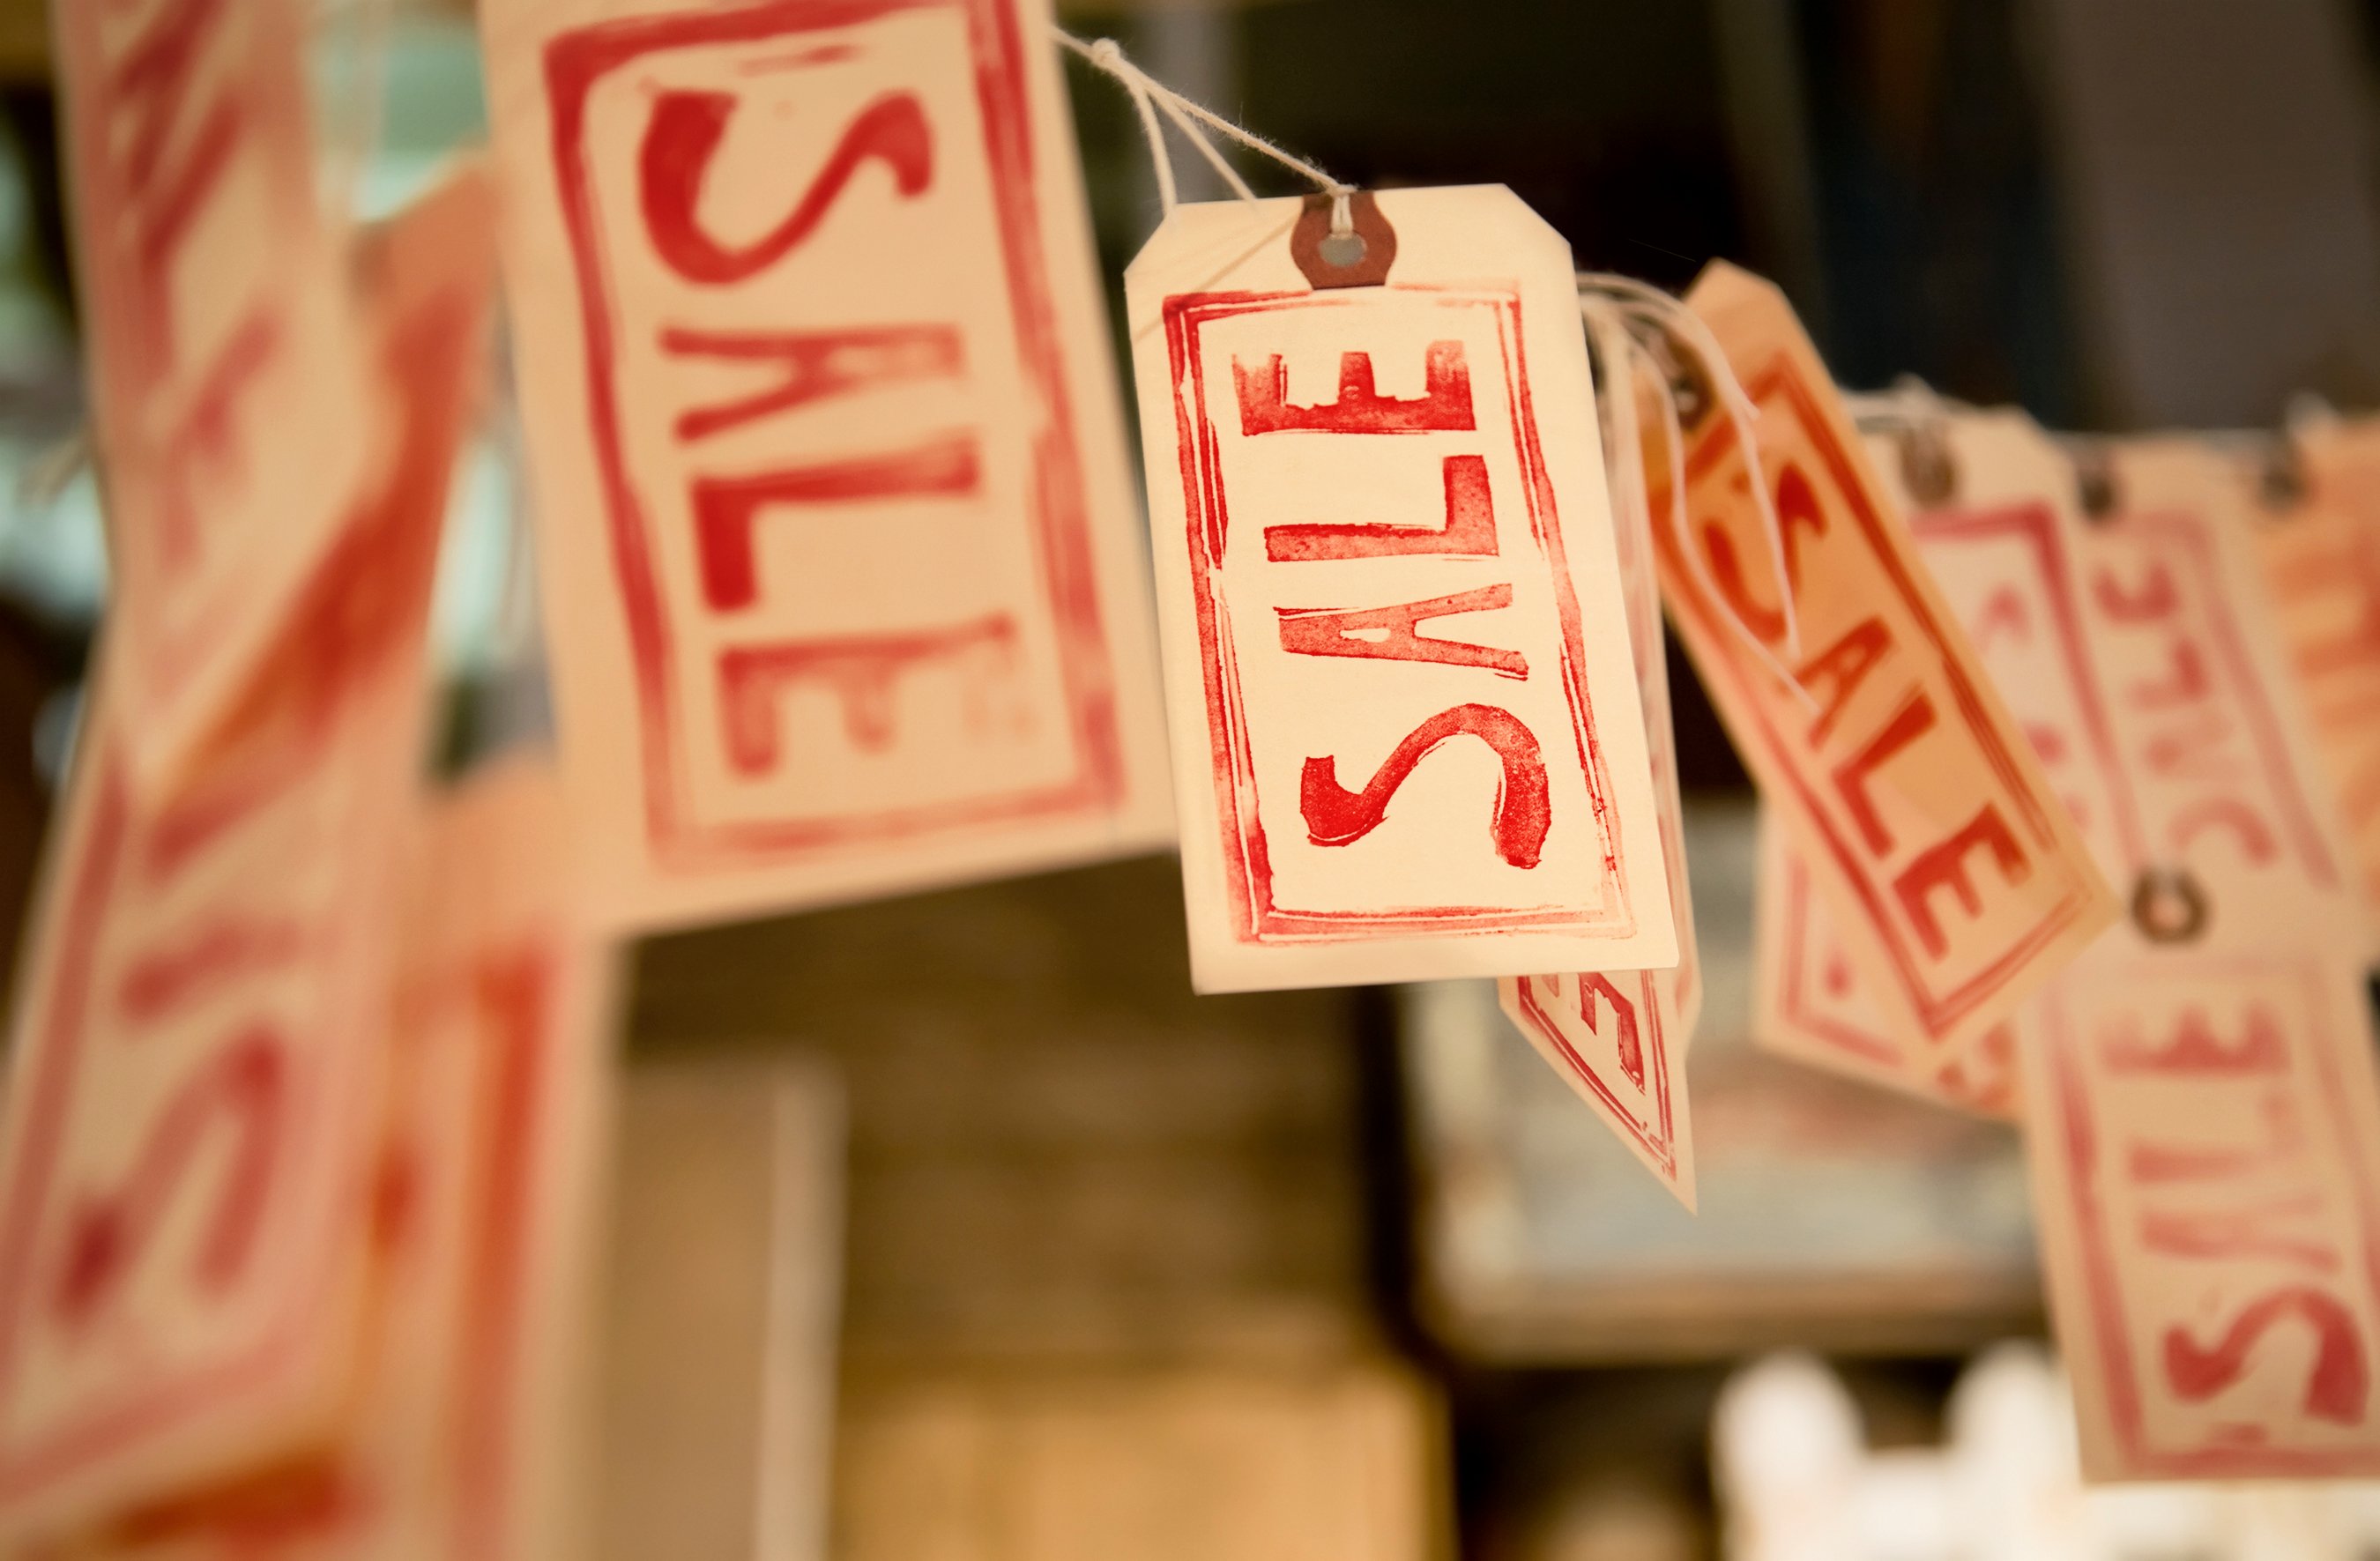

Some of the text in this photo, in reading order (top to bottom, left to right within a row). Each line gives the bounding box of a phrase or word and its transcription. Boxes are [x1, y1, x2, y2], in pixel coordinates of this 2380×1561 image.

[639, 88, 1035, 781] SALE
[1231, 338, 1551, 869] SALE
[1701, 460, 2034, 963] SALE
[2100, 1001, 2371, 1430] SALE
